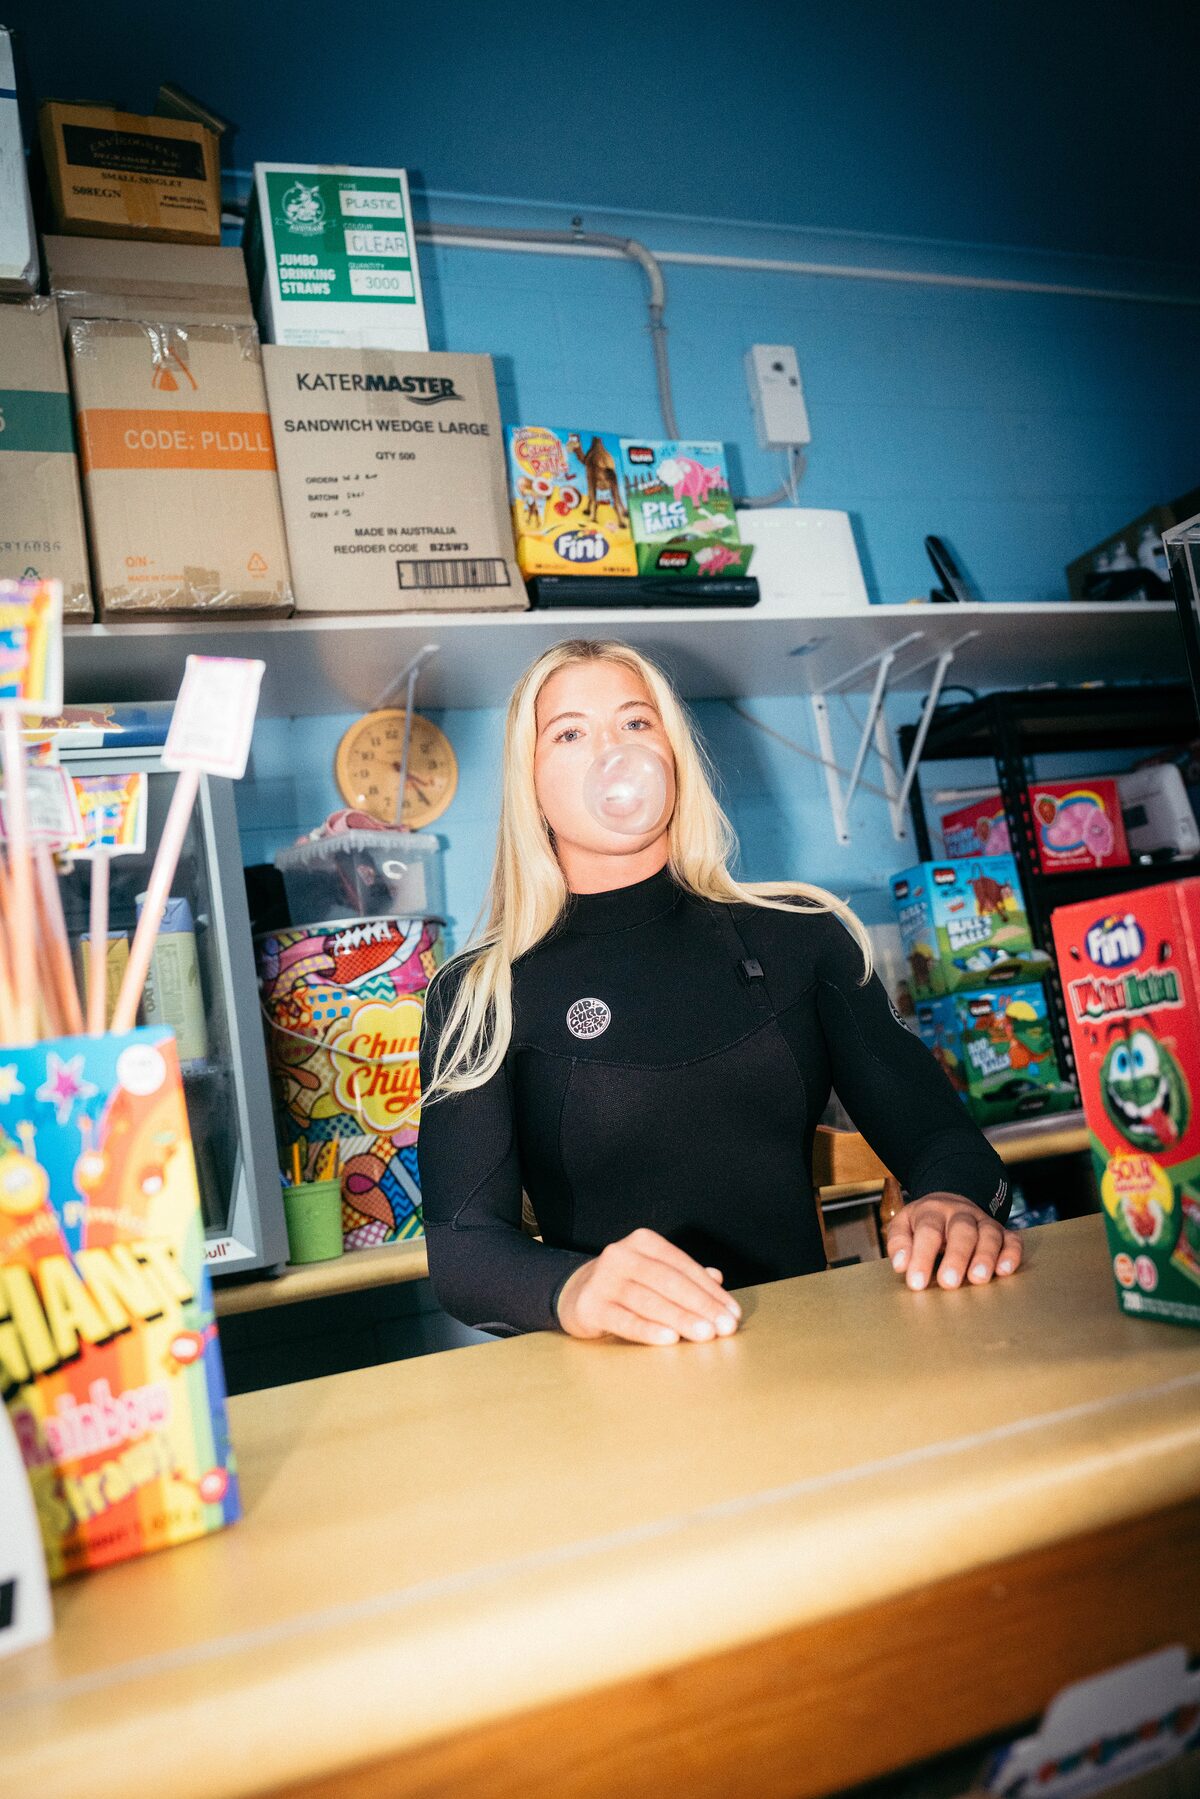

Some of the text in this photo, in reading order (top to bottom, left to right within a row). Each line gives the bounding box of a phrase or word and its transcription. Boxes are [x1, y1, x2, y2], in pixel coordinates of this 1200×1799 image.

[345, 198, 397, 210] PLASTIC
[351, 235, 405, 253] CLEAR
[279, 254, 318, 266] JUMBO
[279, 268, 336, 281] DRINKING
[281, 281, 331, 295] STRAWS
[365, 276, 399, 290] 3000
[296, 373, 456, 396] KATERMASTER
[284, 419, 491, 437] SANDWICH WEDGE LARGE
[124, 429, 271, 453] CODE: PLDLL
[375, 451, 416, 461] QTY 500
[642, 501, 685, 518] PIG
[354, 526, 456, 537] MADE IN AUSTRALIA
[333, 545, 386, 555] REORDER
[388, 543, 419, 554] CODE
[557, 532, 606, 561] Fini
[1087, 913, 1142, 966] Fini
[570, 1001, 592, 1019] RIP
[570, 1007, 608, 1028] CURL
[205, 1243, 226, 1259] ull
